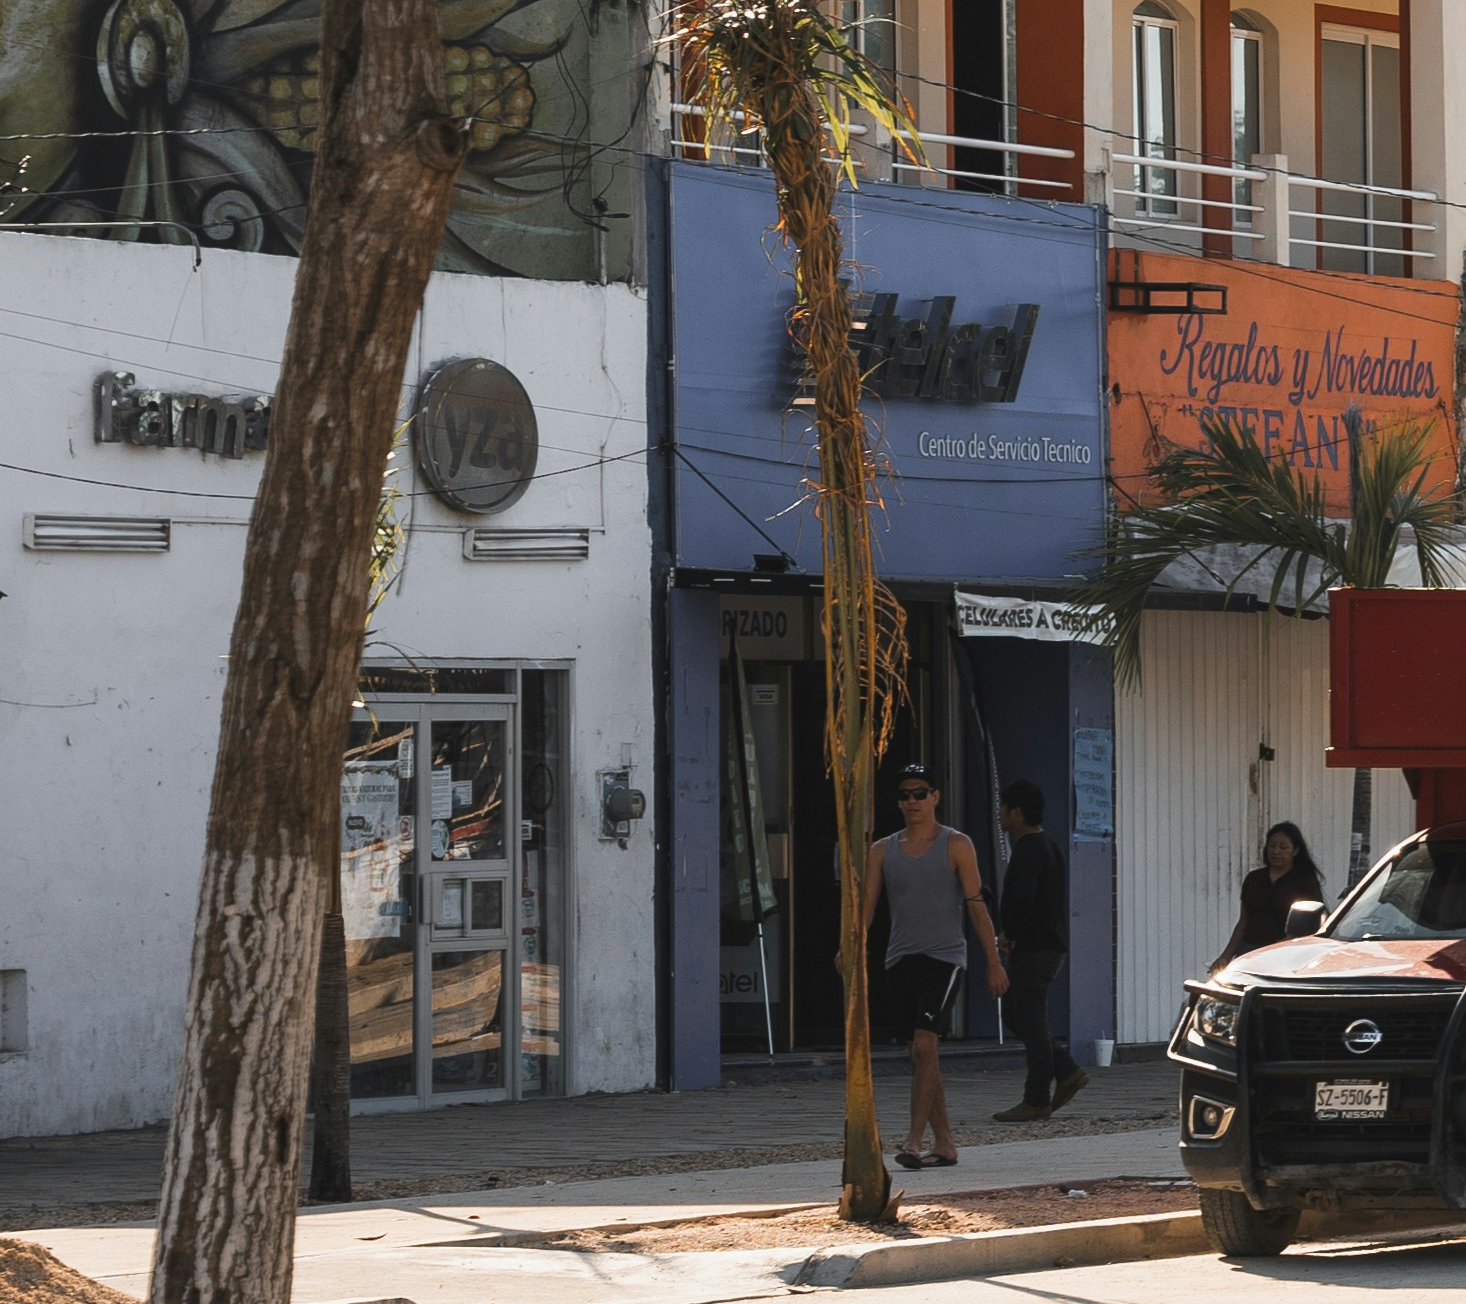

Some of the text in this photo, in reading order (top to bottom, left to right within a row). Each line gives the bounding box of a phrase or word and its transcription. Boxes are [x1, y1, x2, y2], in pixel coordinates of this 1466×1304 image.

[1160, 313, 1285, 404] Regalos
[1287, 347, 1313, 406] y
[1307, 325, 1440, 399] Novedades
[919, 431, 1091, 465] Centro de Servicio Tecnico
[1035, 607, 1050, 629] A
[1341, 1110, 1385, 1119] NISSAN
